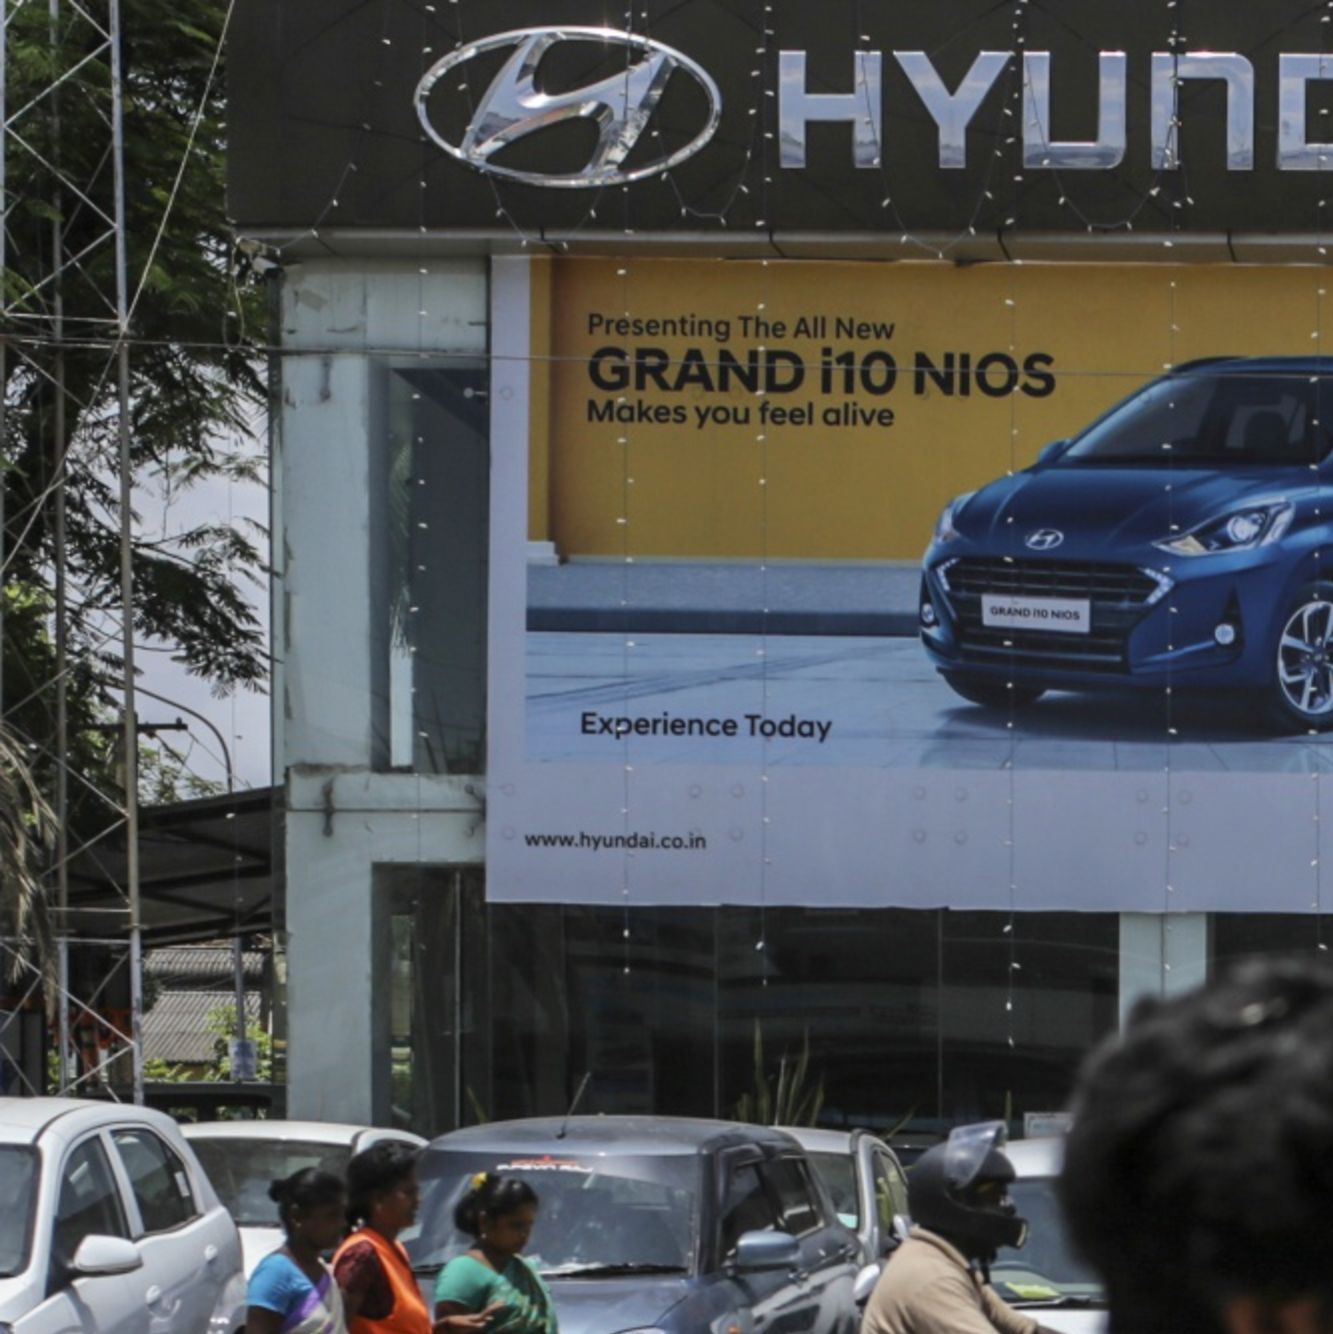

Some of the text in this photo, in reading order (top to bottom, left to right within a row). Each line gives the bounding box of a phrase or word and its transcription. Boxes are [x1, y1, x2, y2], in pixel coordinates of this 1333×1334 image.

[588, 313, 895, 343] Presenting The All New
[588, 346, 1056, 398] GRAND i10 NIOS
[586, 399, 895, 428] Makes you feel alive
[990, 605, 1031, 618] GRAND
[1051, 609, 1081, 621] NIOS
[581, 711, 832, 744] Experience Today
[524, 830, 707, 852] www.hyundai.co.in
